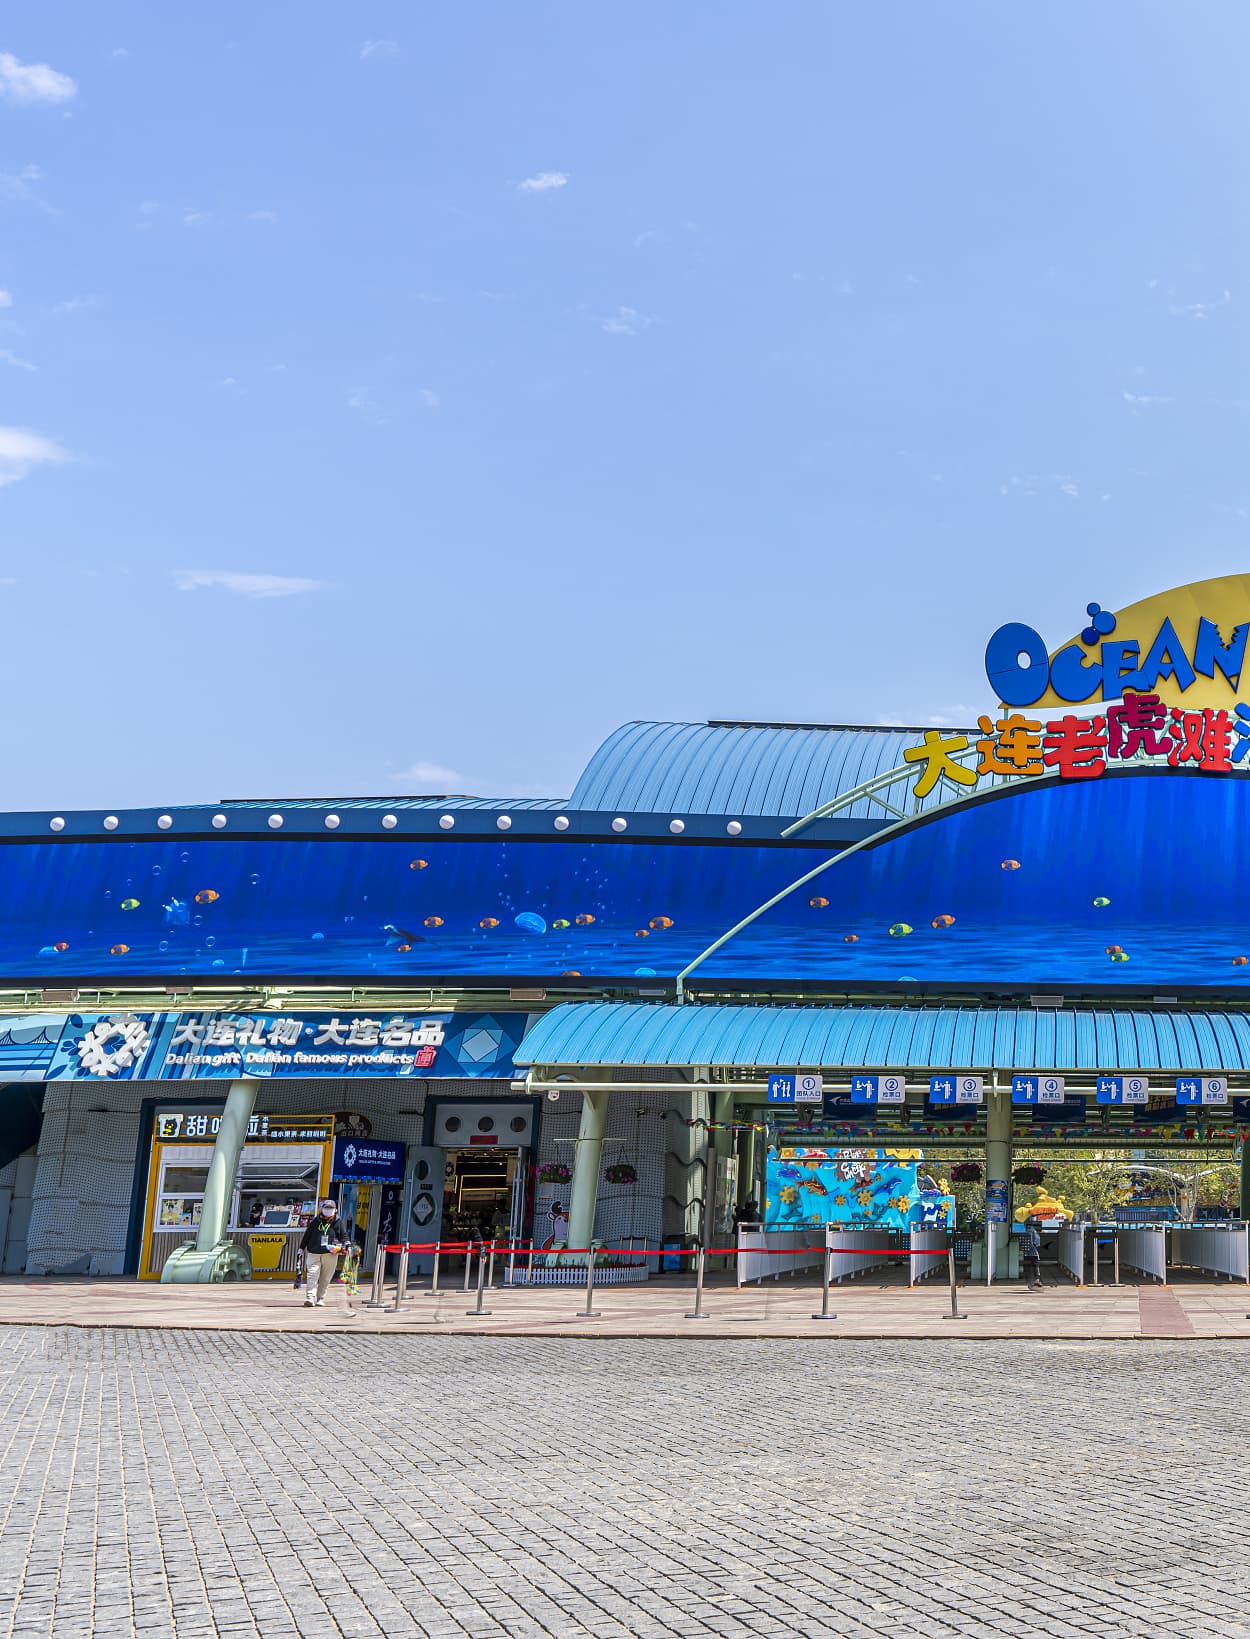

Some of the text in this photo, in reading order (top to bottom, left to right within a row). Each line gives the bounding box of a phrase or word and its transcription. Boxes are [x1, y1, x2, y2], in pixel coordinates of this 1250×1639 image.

[985, 615, 1250, 707] OCEAN
[171, 1018, 446, 1047] 大连礼物·大连名品
[165, 1053, 210, 1065] Dalian
[211, 1052, 242, 1067] gift
[246, 1051, 292, 1064] Dalian
[293, 1051, 347, 1064] famous
[349, 1052, 415, 1067] products
[250, 1236, 283, 1244] TIANLALA
